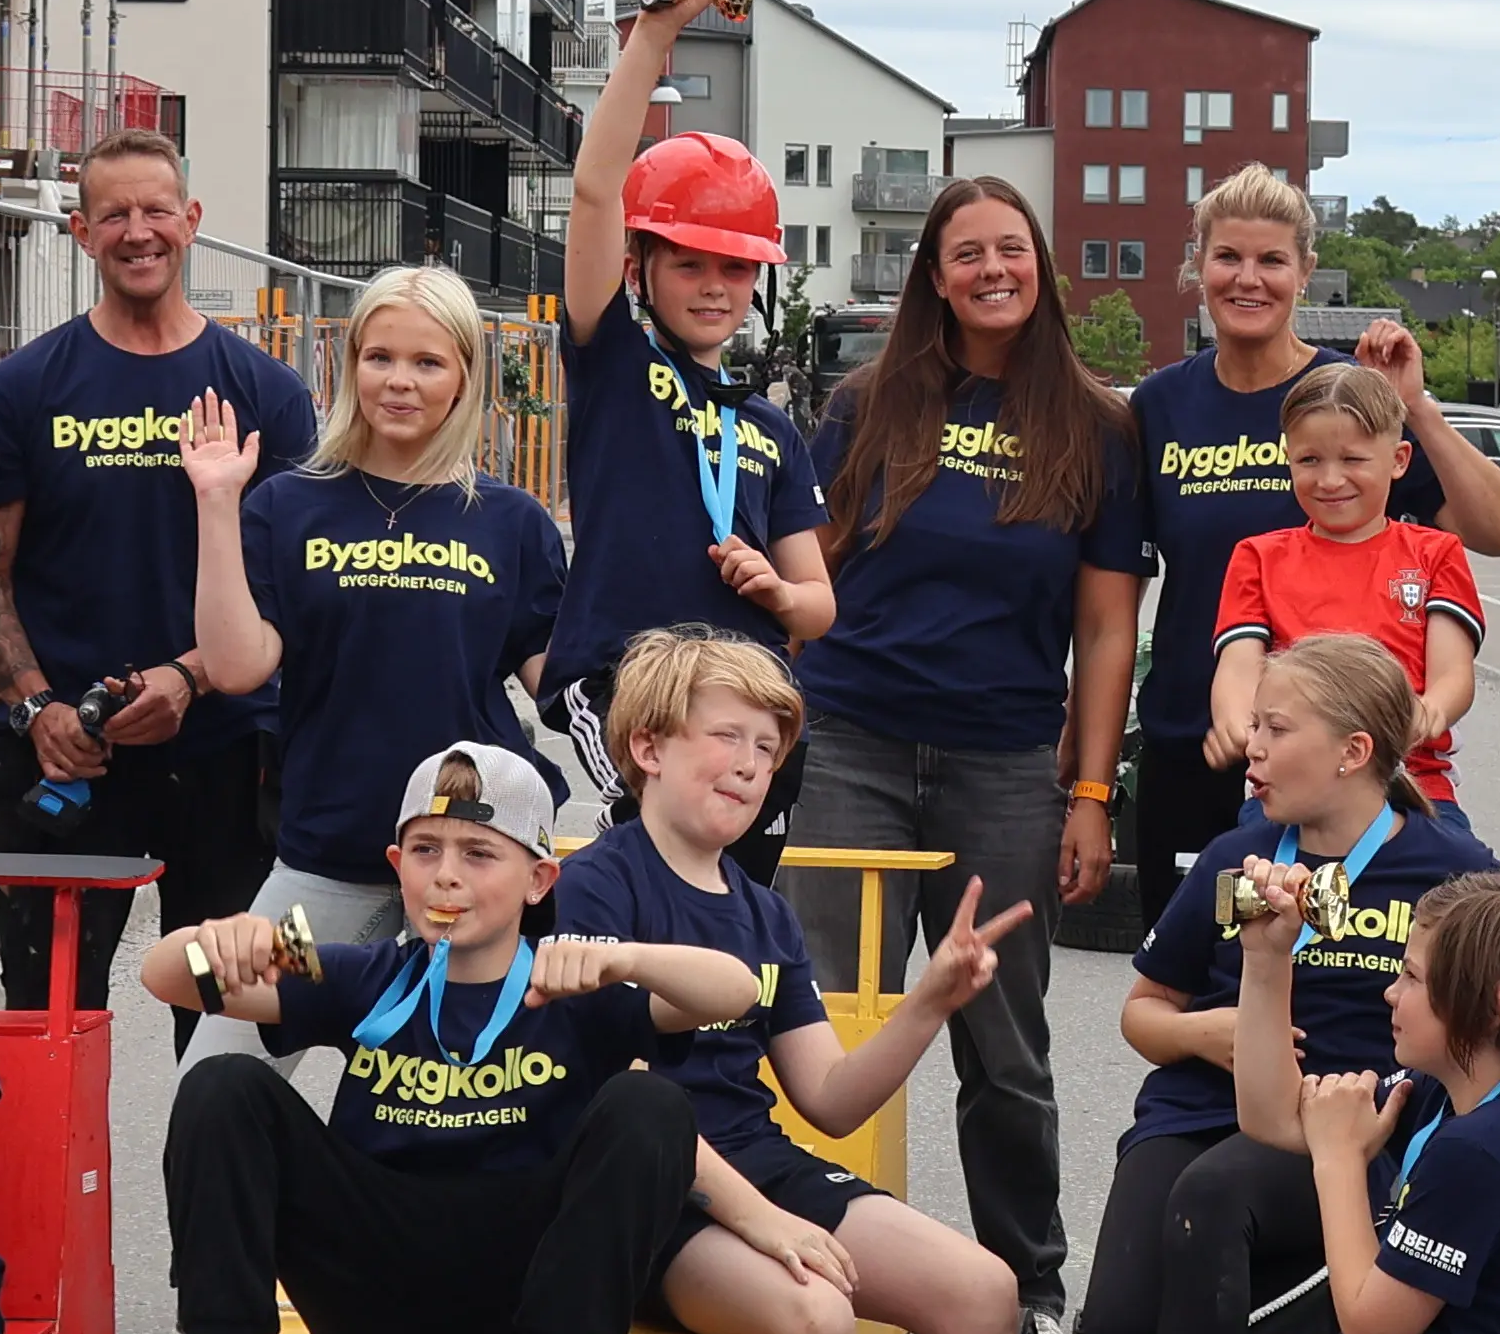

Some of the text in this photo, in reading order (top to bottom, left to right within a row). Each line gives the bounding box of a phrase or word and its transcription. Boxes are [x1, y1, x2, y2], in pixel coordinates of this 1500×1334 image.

[1180, 478, 1292, 496] BYGGFÖRETAGEN
[305, 532, 495, 584] Byggkollo.
[339, 573, 467, 596] BYGGFÖRETAGEN
[374, 1103, 527, 1128] BYGGFÖRETAGEN
[1400, 1244, 1461, 1275] BYGGMATERIAL
[1403, 1228, 1467, 1269] BEIJER
